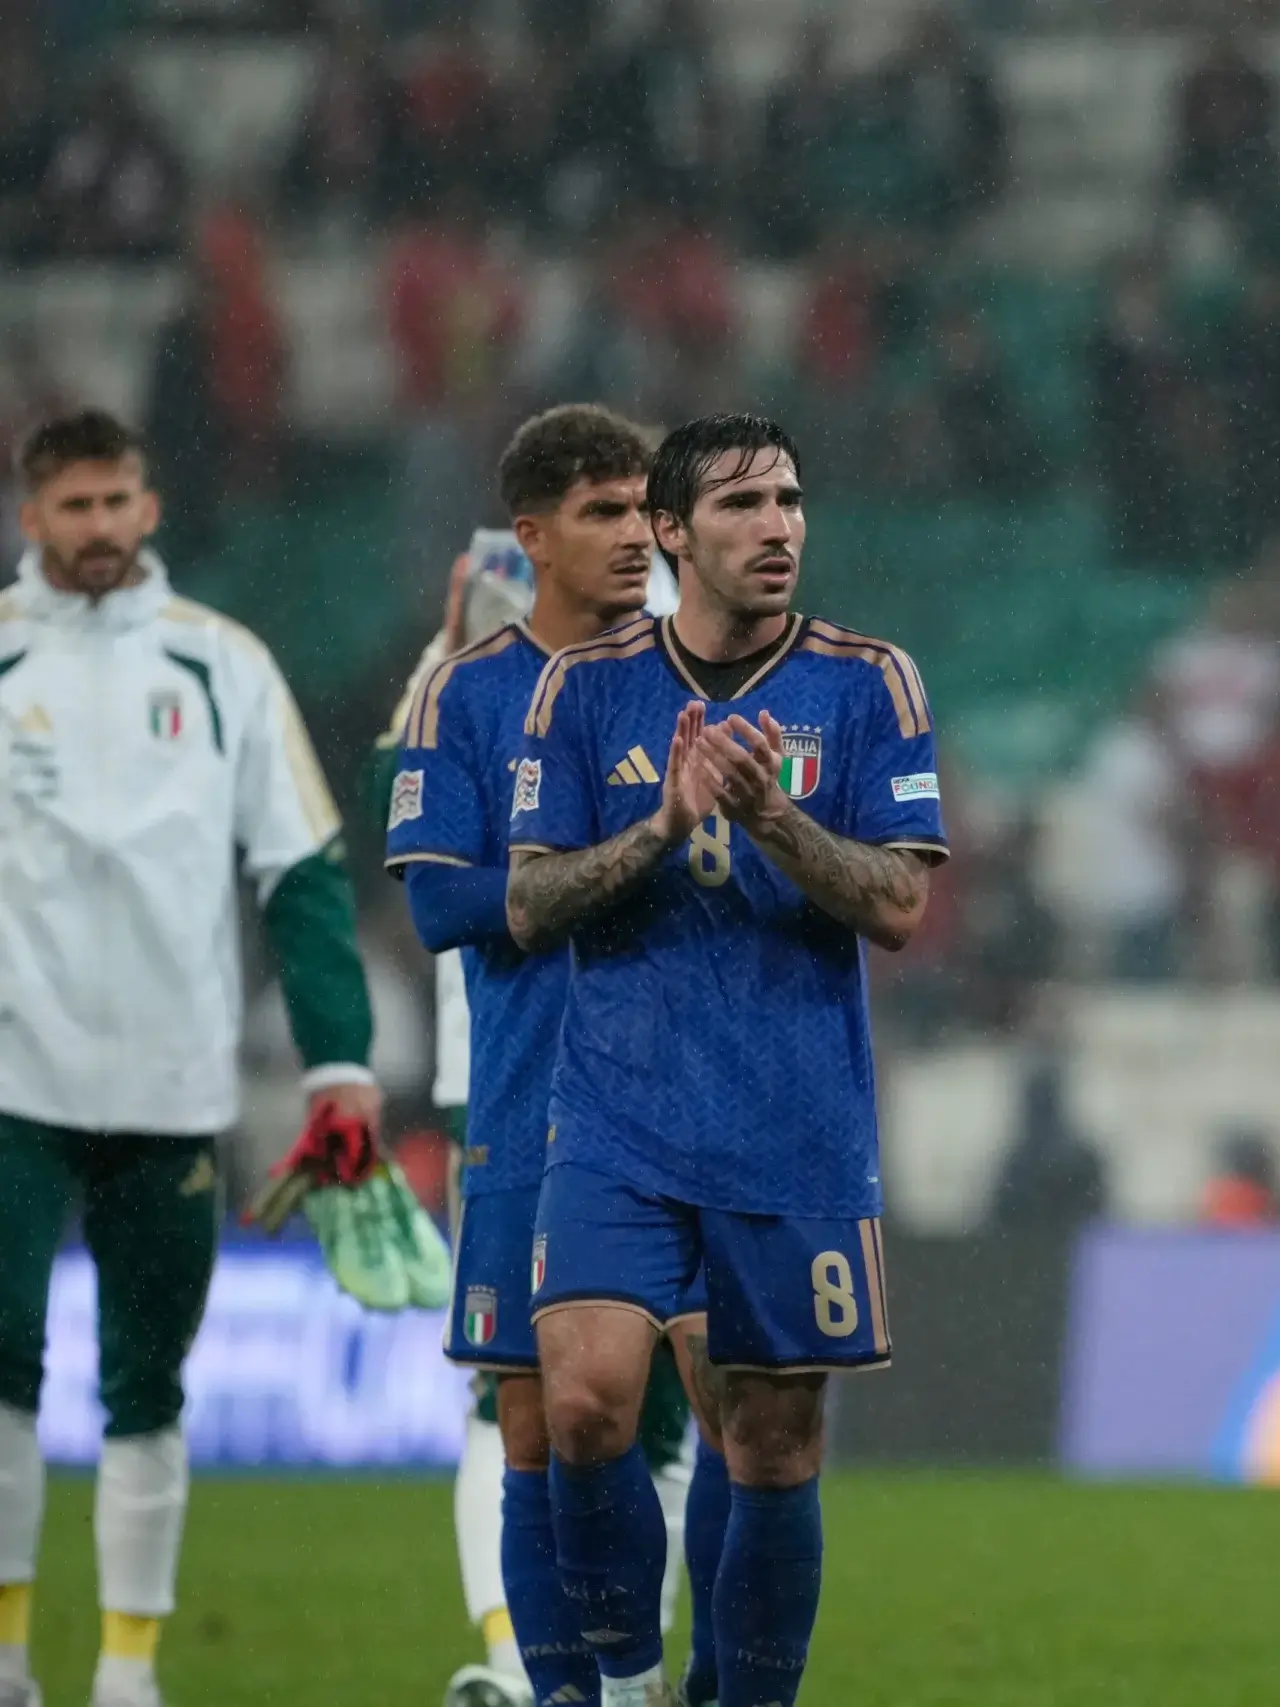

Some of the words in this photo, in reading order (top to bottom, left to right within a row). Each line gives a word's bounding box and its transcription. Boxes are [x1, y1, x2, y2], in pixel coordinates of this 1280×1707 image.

[782, 738, 817, 753] TALIA
[689, 801, 731, 888] 8
[810, 1250, 858, 1337] 8
